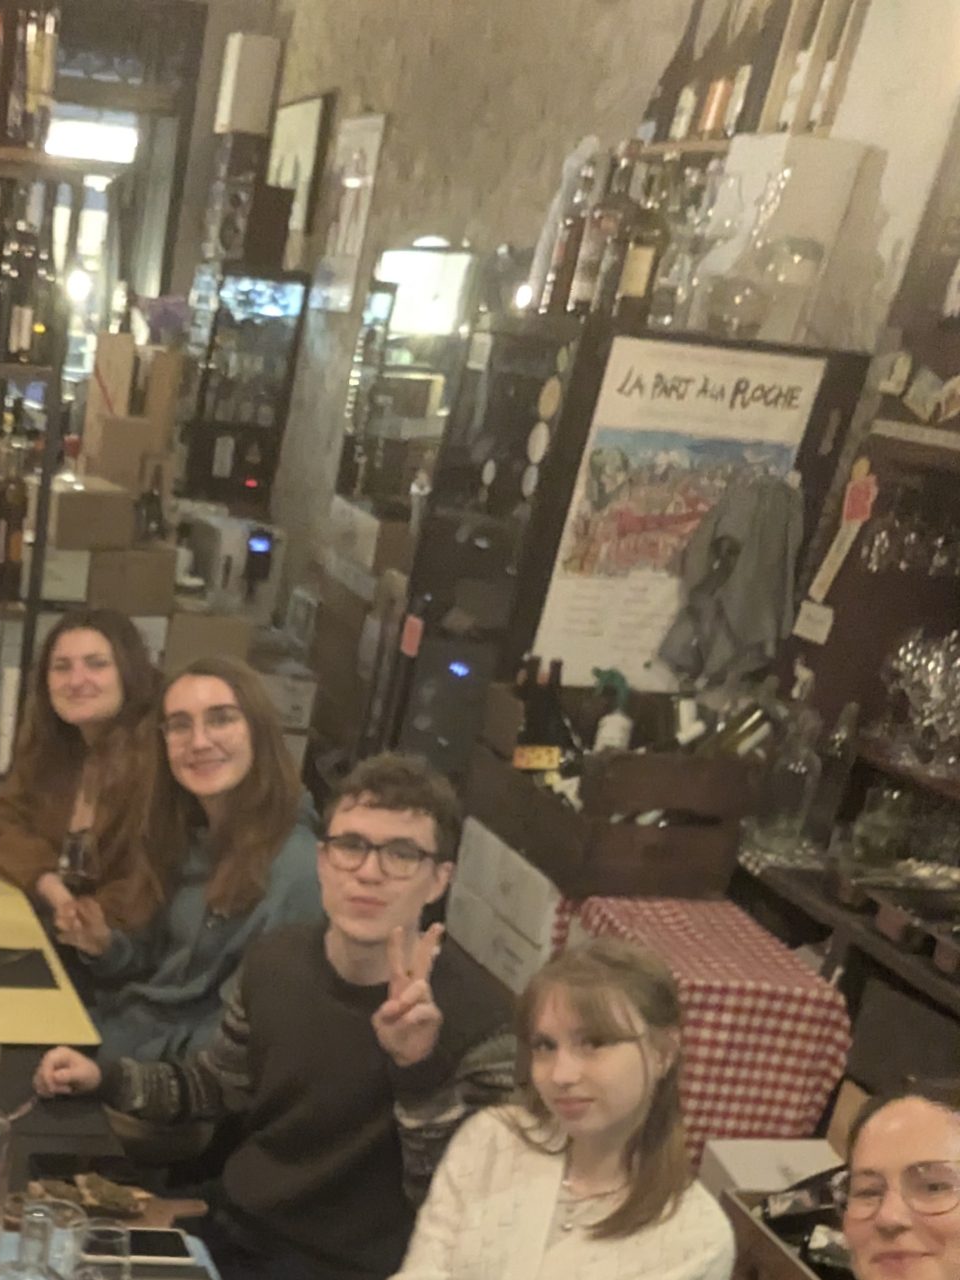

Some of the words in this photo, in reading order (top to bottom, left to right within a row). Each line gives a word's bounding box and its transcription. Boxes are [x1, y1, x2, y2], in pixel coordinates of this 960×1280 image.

[616, 365, 644, 397] LA
[651, 371, 695, 401] PART
[729, 376, 803, 411] ROCHE
